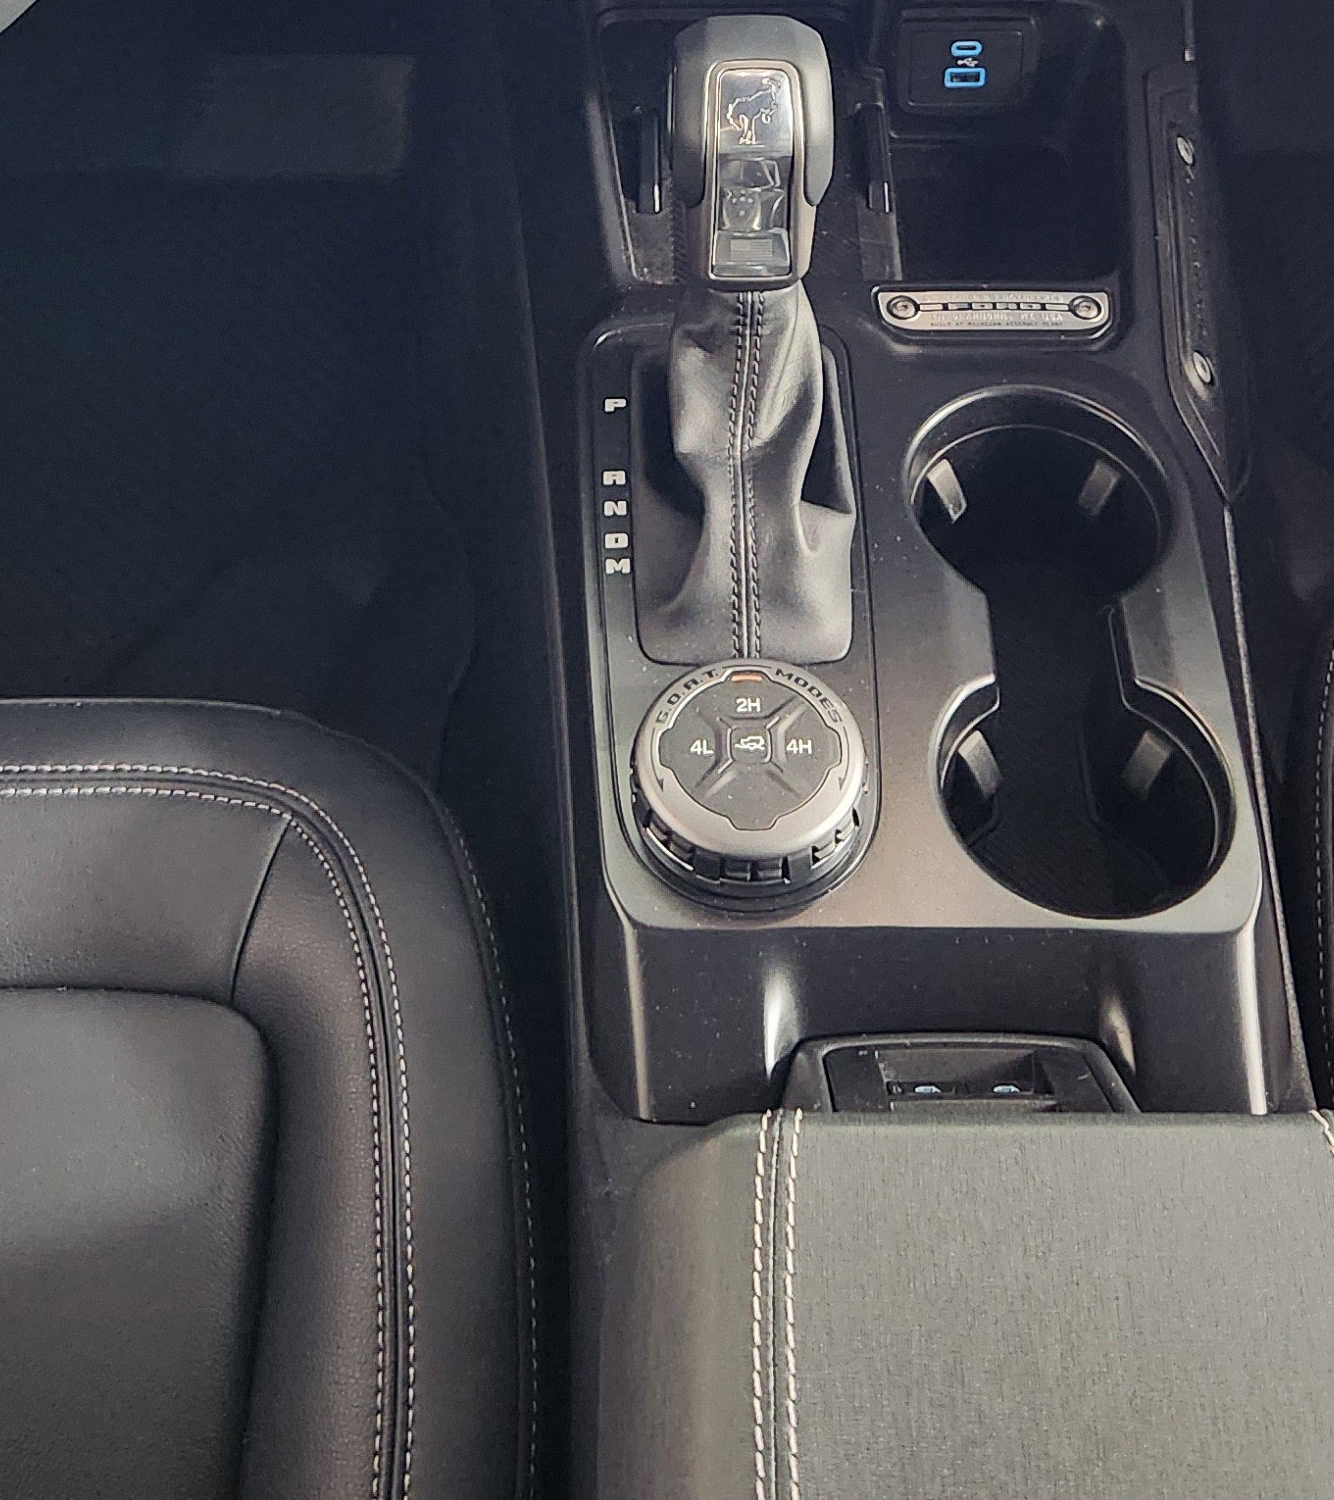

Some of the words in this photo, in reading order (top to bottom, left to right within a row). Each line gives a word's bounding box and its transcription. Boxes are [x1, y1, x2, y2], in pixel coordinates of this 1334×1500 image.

[604, 398, 627, 412] P
[603, 500, 627, 516] N
[605, 558, 631, 574] M
[774, 667, 843, 724] MODES
[735, 698, 762, 712] 2H
[690, 739, 715, 755] 4L
[786, 739, 813, 755] 4H
